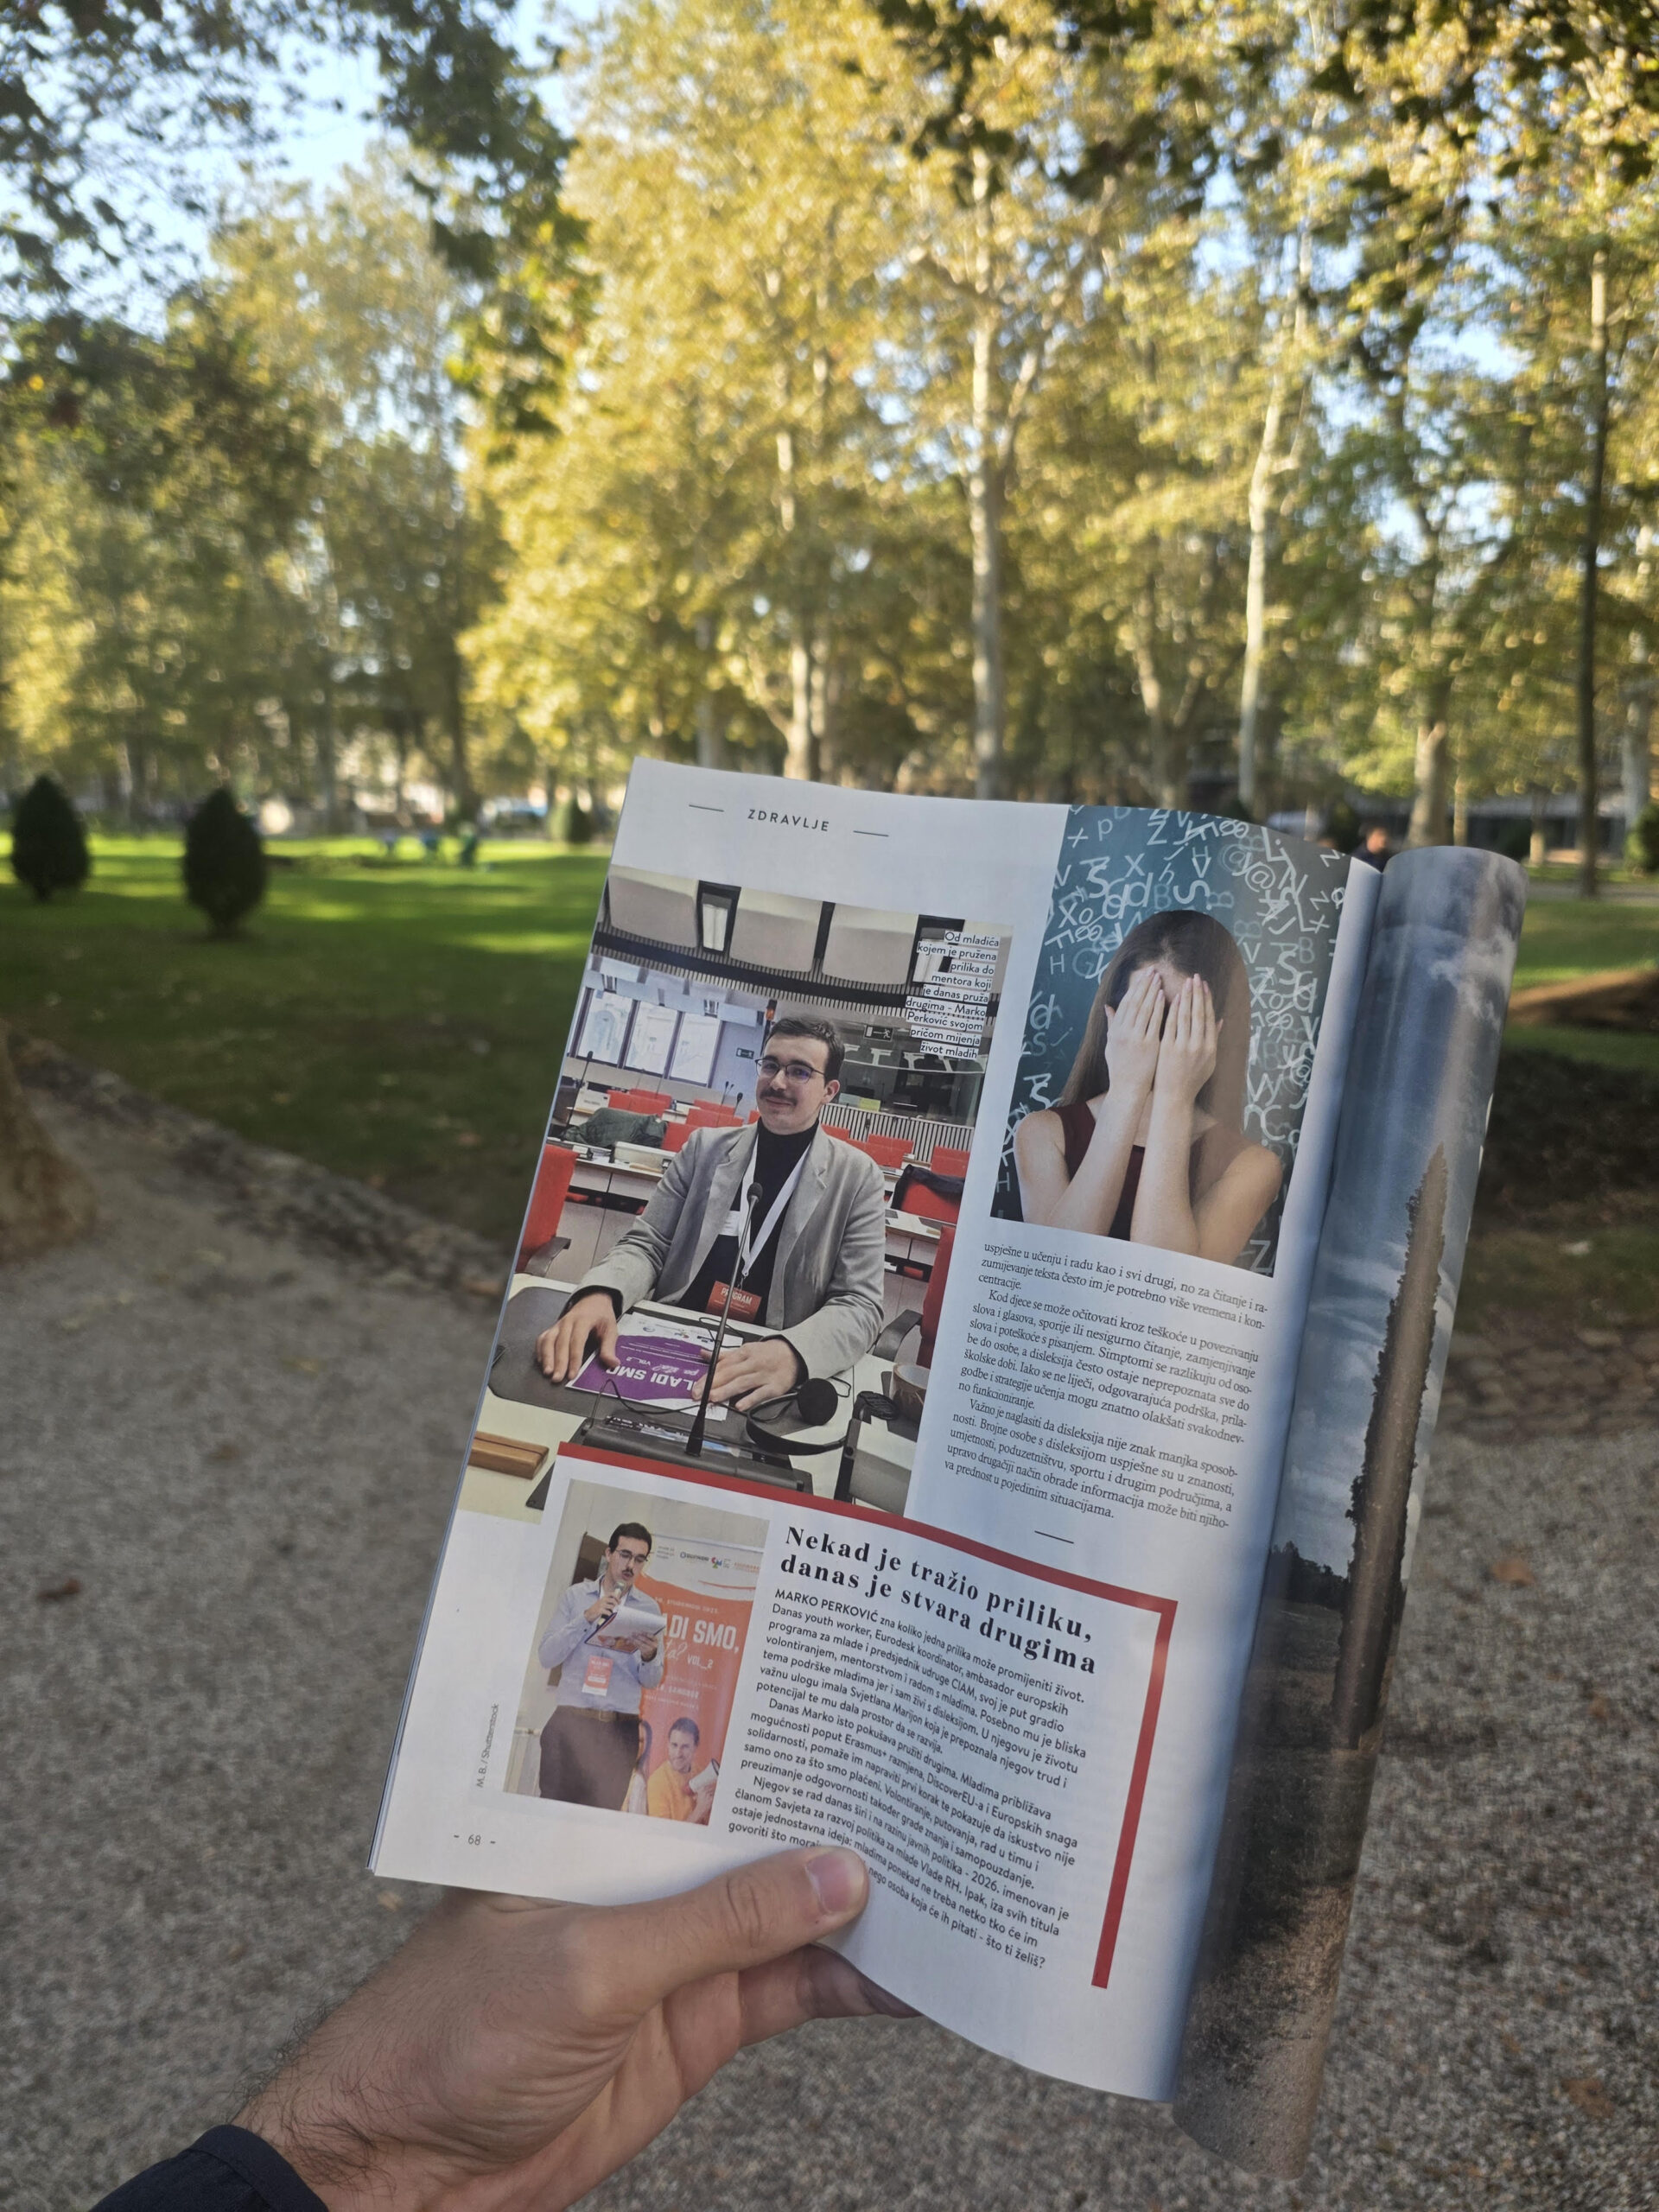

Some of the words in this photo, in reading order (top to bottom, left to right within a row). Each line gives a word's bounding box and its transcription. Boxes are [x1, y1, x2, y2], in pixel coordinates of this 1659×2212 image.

[748, 809, 830, 831] ZDRAVLJE
[917, 943, 945, 955] kojem
[949, 946, 957, 957] je
[959, 949, 996, 961] pružena
[945, 931, 960, 942] Od
[963, 935, 999, 947] mladića
[950, 962, 979, 973] prilika
[906, 997, 944, 1011] drugima
[955, 1006, 985, 1016] Marko
[923, 985, 931, 995] je
[933, 988, 960, 998] danas
[963, 992, 988, 1002] pruža
[931, 975, 972, 986] mentora
[975, 978, 991, 991] koji
[907, 1011, 947, 1026] Perković
[950, 1020, 982, 1032] svojom
[910, 1028, 943, 1039] pričom
[946, 1033, 980, 1046] mijenja
[921, 1042, 943, 1054] život
[946, 1047, 976, 1058] mladih
[972, 1302, 995, 1317] slova
[1001, 1309, 1037, 1327] glasova,
[1038, 1319, 1071, 1334] sporije
[1072, 1323, 1084, 1336] ili
[1085, 1330, 1141, 1349] nesigurno
[1143, 1340, 1182, 1361] čitanje,
[1185, 1352, 1255, 1380] zamjenjivanje
[988, 1289, 1009, 1303] Kod
[1009, 1294, 1032, 1308] djece
[1032, 1300, 1043, 1311] se
[1043, 1304, 1071, 1316] može
[1071, 1308, 1117, 1327] očitovati
[1119, 1317, 1146, 1333] kroz
[1147, 1325, 1188, 1343] teškoće
[1198, 1339, 1259, 1363] povezivanju
[651, 1372, 696, 1390] LADI
[957, 1382, 971, 1392] no
[972, 1382, 1035, 1410] funkcioniranje.
[963, 1348, 996, 1366] školske
[997, 1357, 1018, 1371] dobi.
[1020, 1361, 1040, 1376] Iako
[1041, 1370, 1052, 1380] se
[1052, 1373, 1066, 1382] ne
[1067, 1372, 1095, 1392] liječi,
[1097, 1383, 1172, 1409] odgovarajuća
[1173, 1402, 1219, 1423] podrška,
[1221, 1414, 1247, 1427] prila-
[967, 1332, 979, 1345] be
[980, 1336, 992, 1349] do
[993, 1342, 1020, 1357] osobe,
[1029, 1348, 1073, 1369] disleksija
[1075, 1358, 1104, 1375] često
[1106, 1369, 1140, 1384] ostaje
[1141, 1376, 1217, 1403] neprepoznata
[1218, 1396, 1236, 1408] sve
[1236, 1398, 1250, 1412] do
[960, 1366, 989, 1381] godbe
[994, 1375, 1033, 1393] strategije
[1033, 1383, 1065, 1401] učenja
[1067, 1394, 1098, 1409] mogu
[1100, 1402, 1141, 1418] znatno
[1141, 1410, 1185, 1430] olakšati
[1186, 1422, 1244, 1444] svakodnev-
[950, 1429, 996, 1452] umjetnosti,
[998, 1443, 1066, 1472] poduzetništvu,
[1069, 1464, 1105, 1480] sportu
[1114, 1472, 1156, 1493] drugim
[1158, 1486, 1223, 1512] područjima,
[952, 1414, 977, 1427] nosti.
[979, 1417, 1008, 1436] Brojne
[1009, 1429, 1037, 1445] osobe
[1046, 1437, 1107, 1463] disleksijom
[1109, 1456, 1160, 1476] uspješne
[1160, 1469, 1174, 1480] su
[1186, 1476, 1235, 1497] znanosti,
[781, 1555, 860, 1588] danas
[865, 1573, 893, 1599] je
[901, 1588, 970, 1630] stvara
[980, 1619, 1096, 1674] drugima
[785, 1526, 870, 1562] Nekad
[874, 1550, 901, 1572] je
[911, 1560, 979, 1600] tražio
[987, 1589, 1092, 1643] priliku,
[772, 1603, 803, 1619] Danas
[804, 1613, 834, 1627] youth
[836, 1621, 872, 1640] worker,
[874, 1629, 916, 1653] Eurodesk
[917, 1644, 964, 1677] koordinator,
[965, 1669, 1015, 1696] ambasador
[1016, 1691, 1069, 1716] europskih
[774, 1588, 818, 1607] MARKO
[821, 1599, 879, 1623] PERKOVIĆ
[880, 1617, 896, 1629] zna
[897, 1620, 923, 1639] koliko
[923, 1630, 945, 1649] jedna
[945, 1643, 971, 1661] prilika
[972, 1656, 996, 1671] može
[997, 1666, 1053, 1693] promijeniti
[1054, 1683, 1084, 1703] život.
[481, 1703, 499, 1758] Shutterstock
[768, 1697, 799, 1715] Danas
[801, 1706, 835, 1723] Marko
[836, 1714, 855, 1730] isto
[855, 1724, 897, 1747] pokušava
[897, 1741, 923, 1760] pružiti
[923, 1753, 958, 1780] drugima.
[960, 1772, 1000, 1800] Mladima
[1001, 1795, 1052, 1821] približava
[750, 1713, 810, 1733] mogućnosti
[811, 1727, 842, 1742] poput
[926, 1772, 984, 1812] DiscoverEU-a
[991, 1805, 1043, 1836] Europskih
[1045, 1830, 1077, 1849] snaga
[467, 1834, 481, 1846] 68
[731, 1806, 763, 1821] ostaje
[764, 1810, 825, 1836] jednostavna
[827, 1827, 853, 1847] ideja:
[854, 1840, 887, 1866] mladima
[887, 1860, 921, 1888] ponekad
[920, 1883, 931, 1894] ne
[932, 1888, 957, 1910] treba
[958, 1904, 987, 1924] netko
[988, 1917, 1006, 1934] tko
[1007, 1926, 1021, 1941] će
[1023, 1931, 1038, 1948] im
